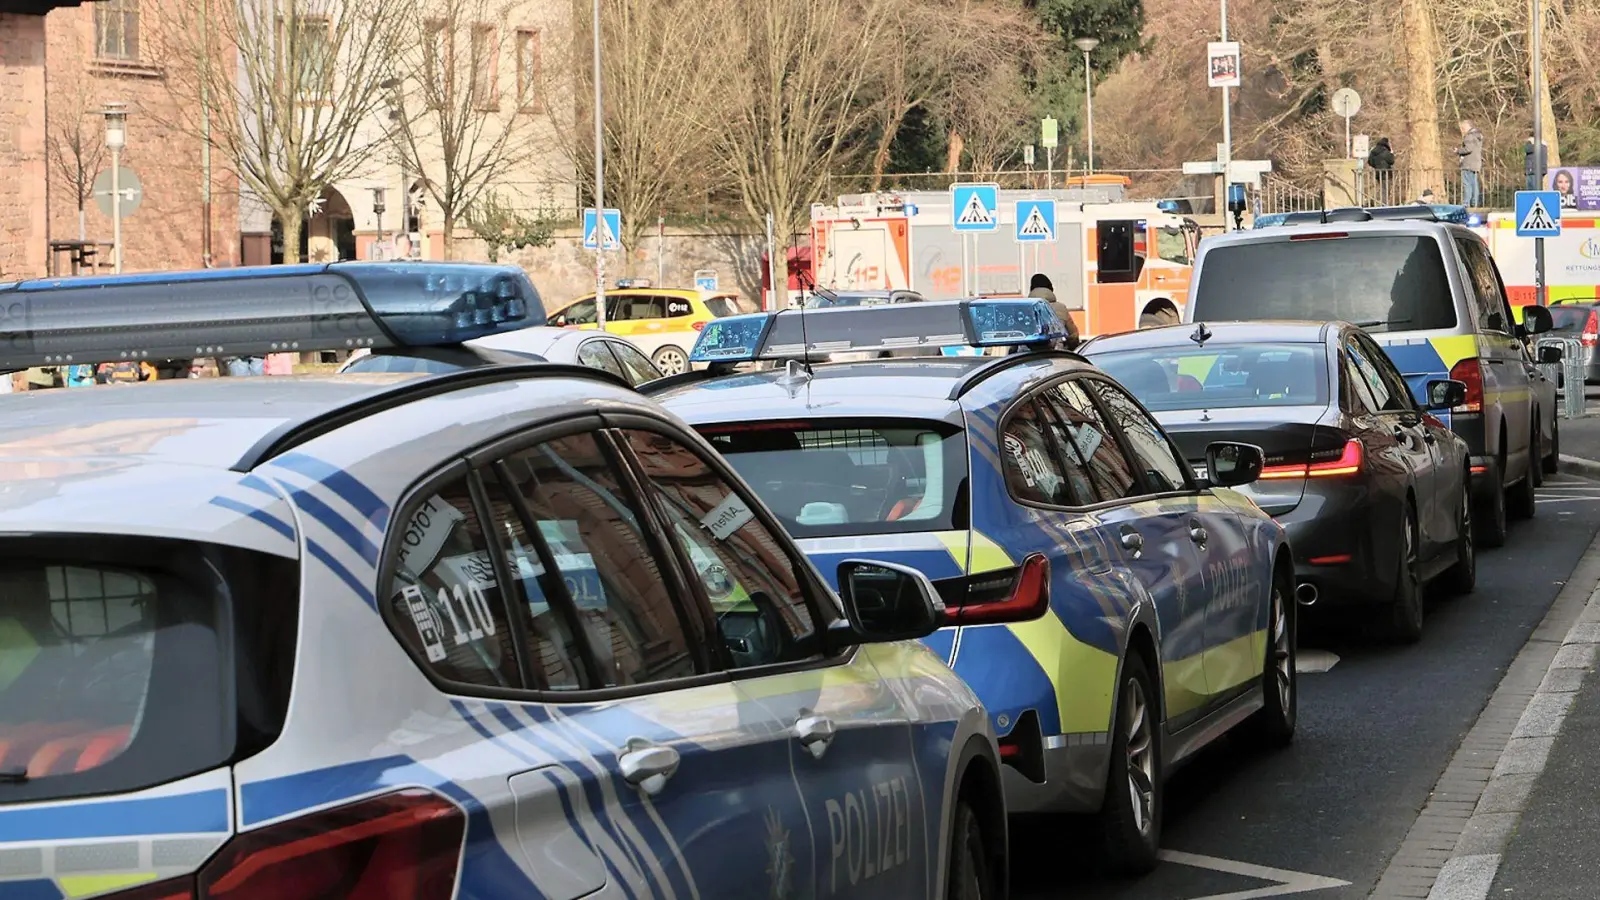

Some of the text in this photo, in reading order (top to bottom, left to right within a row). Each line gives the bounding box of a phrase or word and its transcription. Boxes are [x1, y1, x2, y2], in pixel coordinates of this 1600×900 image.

[855, 266, 878, 283] 112
[437, 580, 496, 645] 110
[1208, 558, 1249, 613] POLIZEI
[825, 775, 910, 895] POLIZEI
